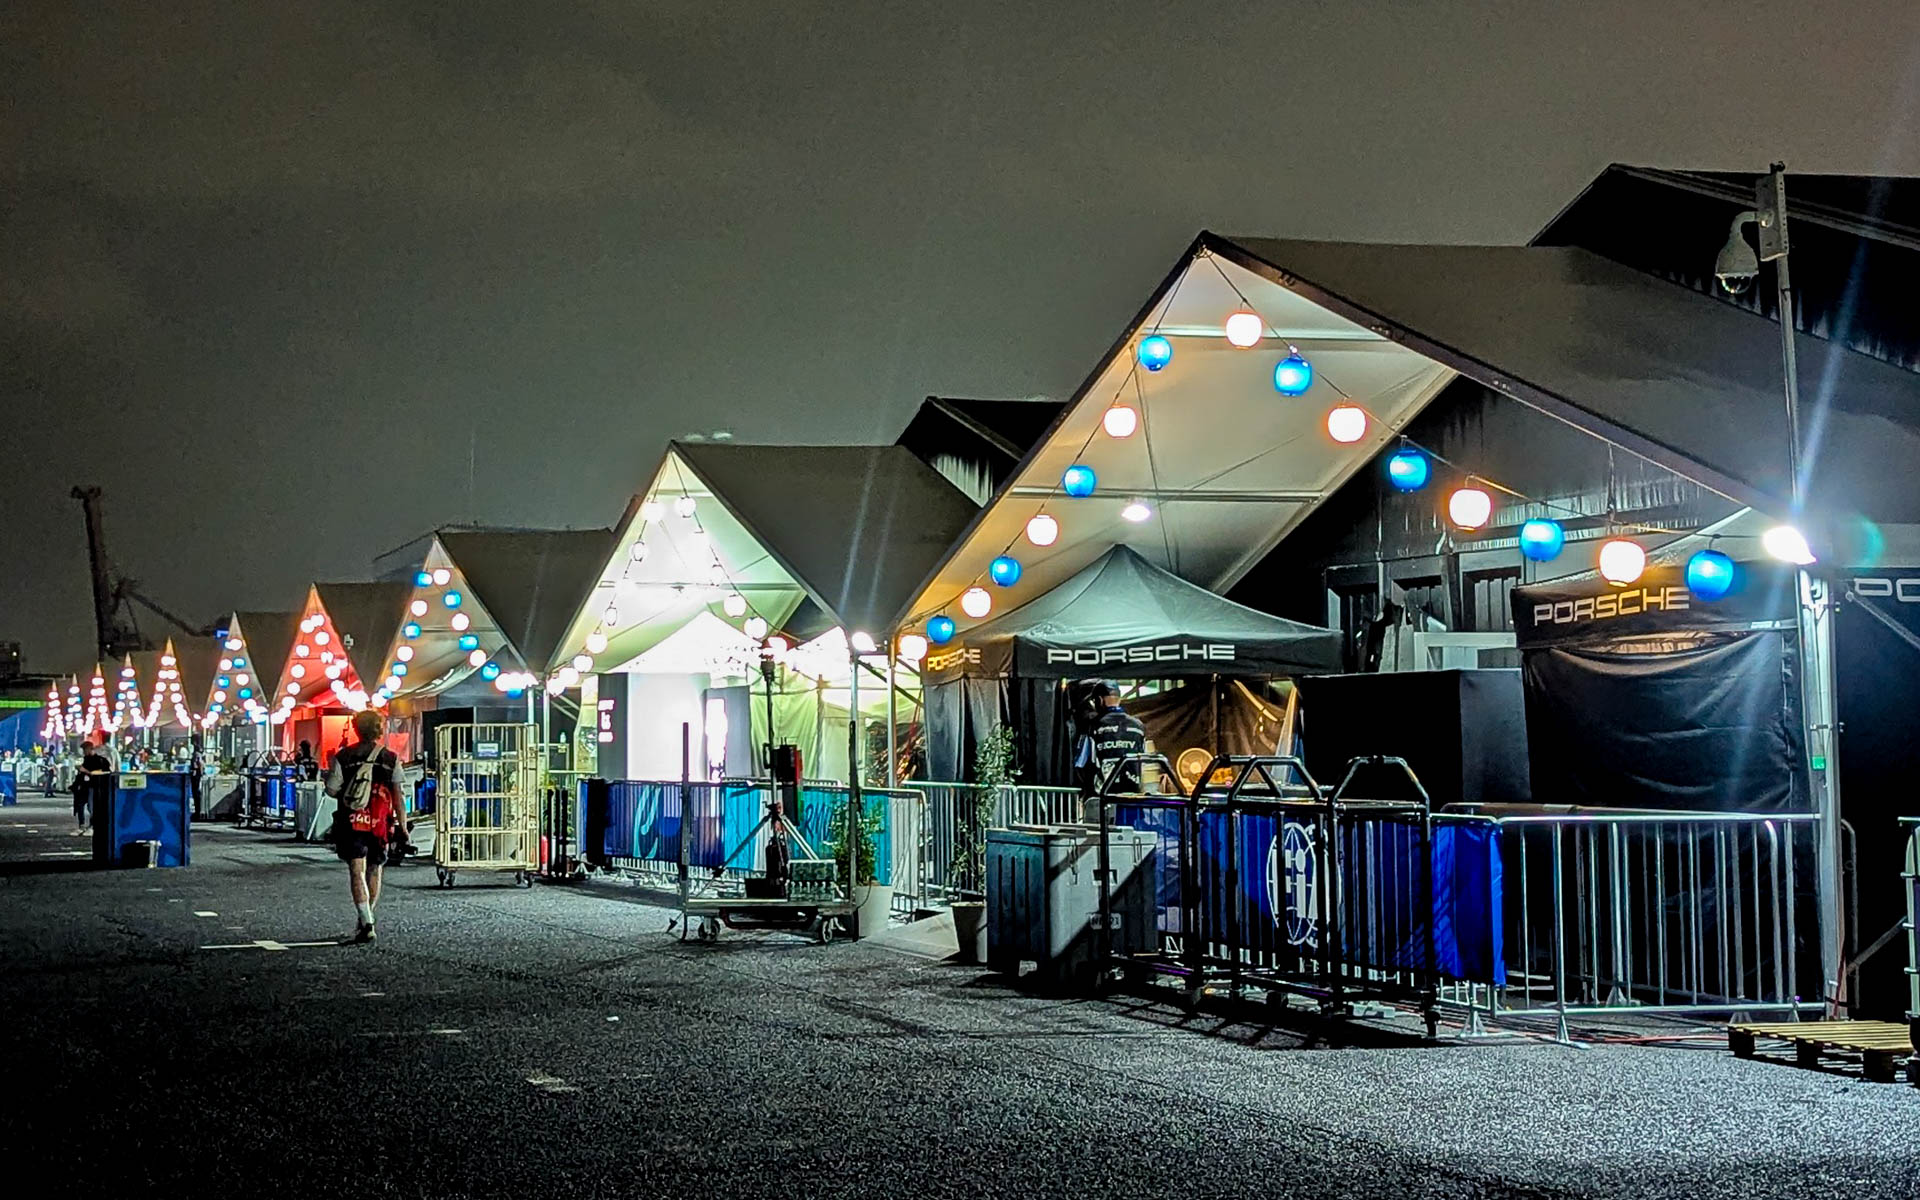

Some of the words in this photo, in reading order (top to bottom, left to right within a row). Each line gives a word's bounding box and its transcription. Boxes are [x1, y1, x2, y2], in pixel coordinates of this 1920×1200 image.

[1533, 586, 1690, 626] PORSCHE
[927, 648, 981, 671] PORSCHE
[1047, 644, 1235, 665] PORSCHE
